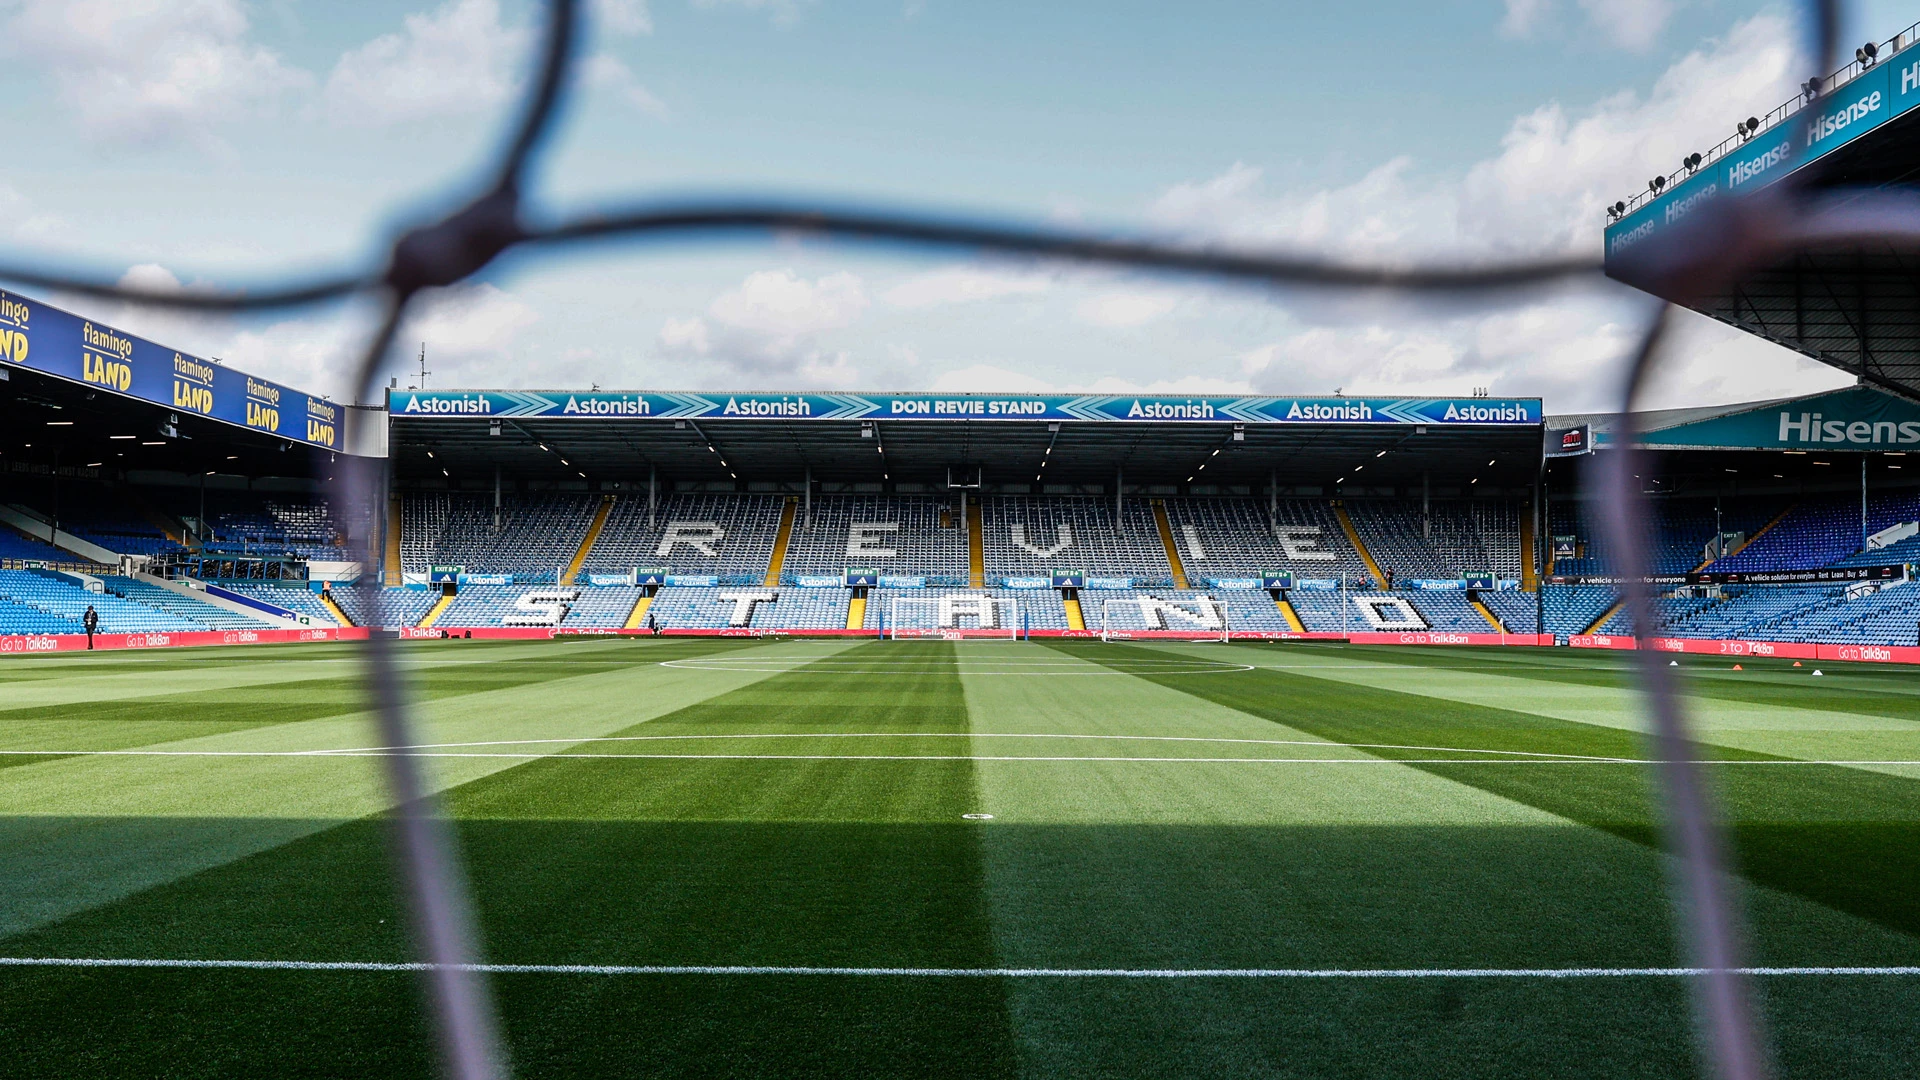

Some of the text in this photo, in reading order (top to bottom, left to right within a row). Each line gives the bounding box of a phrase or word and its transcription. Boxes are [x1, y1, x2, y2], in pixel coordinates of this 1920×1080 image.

[1807, 90, 1880, 146] Hisense
[1729, 141, 1790, 188] Hisense
[1665, 184, 1716, 225] Hisense
[1611, 219, 1654, 256] Hisense
[83, 321, 132, 360] flamingo
[83, 353, 132, 391] LAND
[174, 353, 213, 387] flamingo
[173, 380, 213, 413] LAND
[247, 377, 279, 407] flamingo
[307, 397, 335, 424] flamingo
[405, 394, 490, 414] Astonish
[563, 395, 650, 415] Astonish
[723, 397, 810, 416] Astonish
[891, 400, 1046, 415] DON REVIE STAND
[1128, 399, 1214, 418] Astonish
[1287, 400, 1372, 420] Astonish
[1443, 402, 1528, 421] Astonish
[247, 403, 279, 432] LAND
[307, 419, 335, 446] LAND
[466, 575, 505, 584] Astonish
[591, 576, 627, 584] Astonish
[799, 576, 838, 586] Astonish
[1008, 578, 1047, 587] Astonish
[1218, 579, 1256, 588] Astonish
[1797, 572, 1816, 580] everyone
[1847, 570, 1856, 578] Buy
[1422, 581, 1459, 590] Astonish
[127, 634, 170, 647] Go to TalkBan
[224, 632, 231, 642] Go
[232, 633, 238, 642] to
[300, 630, 306, 640] Go
[306, 632, 311, 640] to
[408, 628, 442, 637] TalkBa
[1400, 634, 1468, 643] Go to TalkBan
[1569, 636, 1580, 646] Go
[1582, 637, 1591, 645] to
[1, 637, 57, 650] Go to TalkBan
[1730, 642, 1742, 652] to
[1838, 646, 1890, 660] Go to TalkBan
